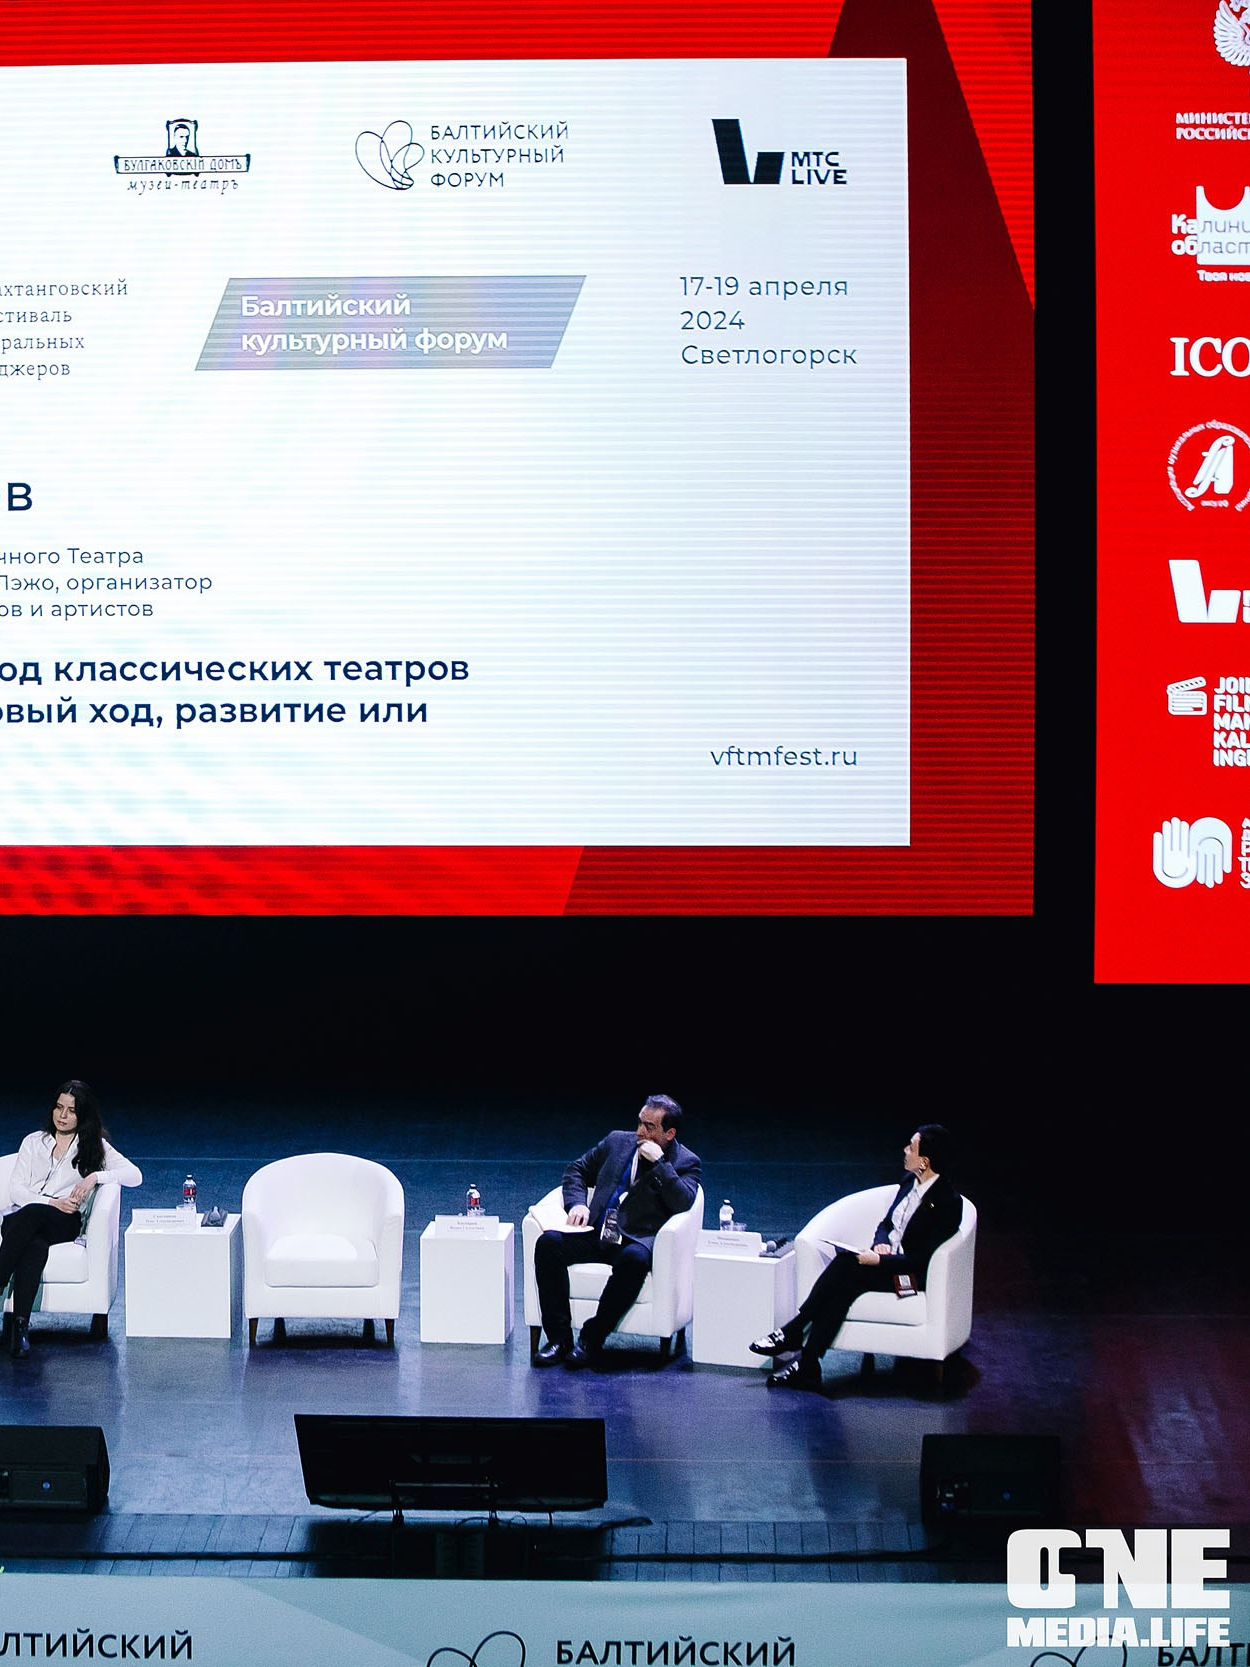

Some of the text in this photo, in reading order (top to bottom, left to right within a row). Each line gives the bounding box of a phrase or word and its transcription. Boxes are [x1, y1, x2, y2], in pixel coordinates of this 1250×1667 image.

[431, 120, 569, 141] БАЛТИЙСКИЙ
[1175, 125, 1250, 141] РОССИЙС
[431, 144, 565, 164] КУЛЬТУРНЫЙ
[430, 171, 504, 188] ФОРУМ
[791, 169, 848, 185] LIVE
[680, 276, 848, 301] 17-19 апреля
[240, 293, 412, 318] Балтийский
[680, 310, 746, 330] 2024
[240, 327, 509, 355] культурный форум
[681, 344, 857, 370] Светлогорск
[66, 548, 144, 567] Театра
[66, 575, 213, 596] организатор
[31, 604, 43, 618] и
[51, 603, 154, 622] артистов
[54, 660, 314, 682] классических
[323, 660, 469, 688] театров
[1213, 676, 1250, 695] JOI
[88, 703, 163, 730] ход,
[176, 702, 347, 730] развитие
[359, 702, 427, 723] или
[710, 744, 858, 767] vftmfest.ru
[556, 1635, 796, 1667] БАЛТИЙСКИЙ
[1157, 1643, 1250, 1667] БАЛТ
